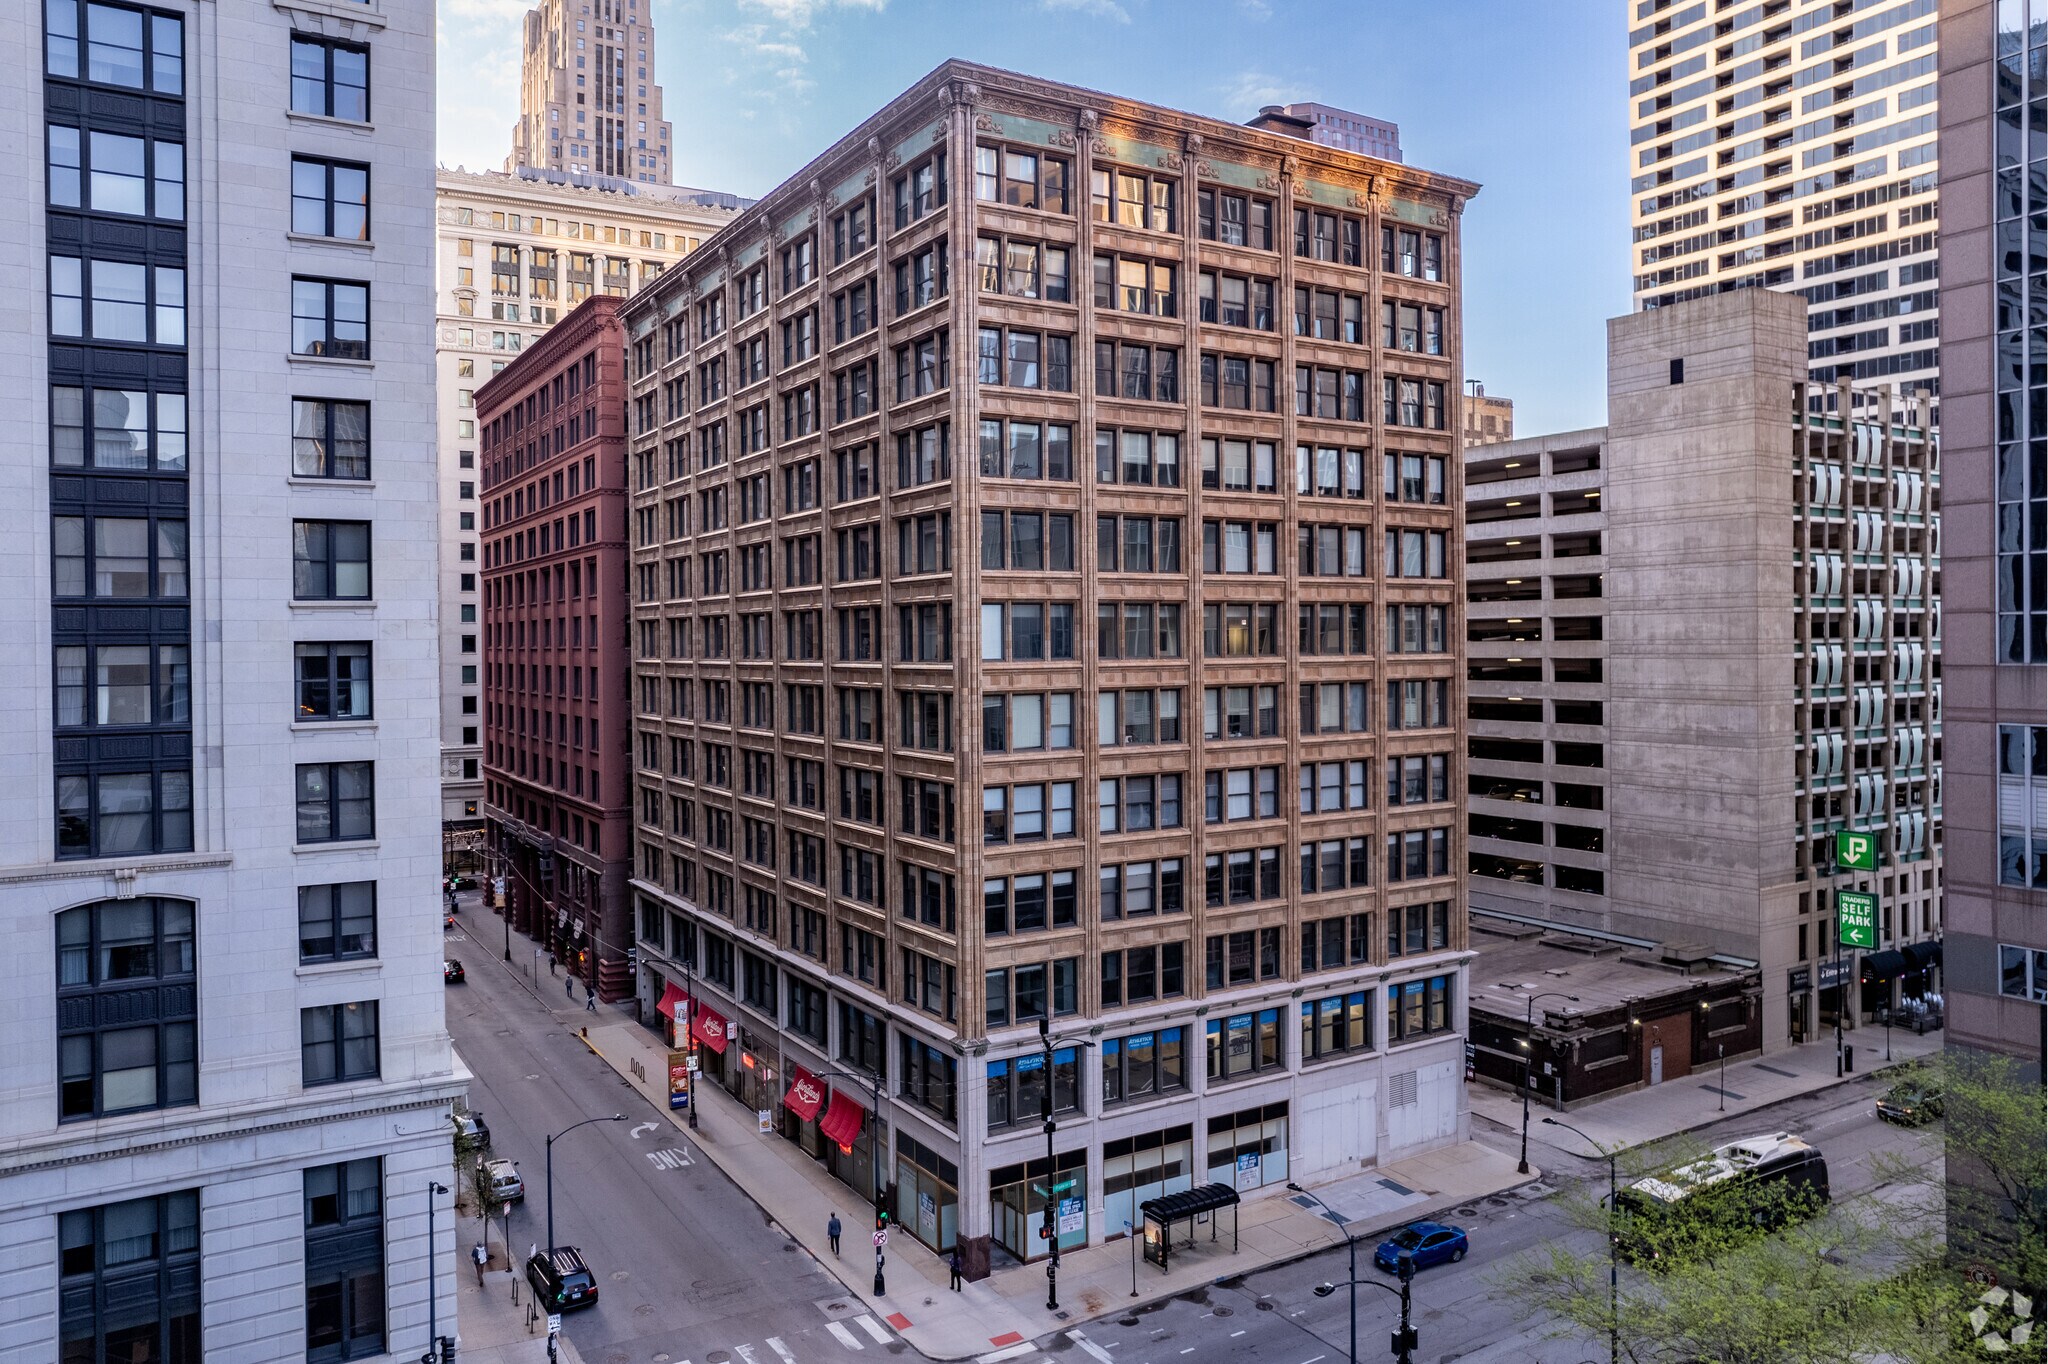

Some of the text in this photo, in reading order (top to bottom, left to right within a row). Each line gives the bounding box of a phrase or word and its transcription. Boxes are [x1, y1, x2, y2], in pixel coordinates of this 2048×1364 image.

[1842, 895, 1870, 905] TRADERS
[1842, 903, 1870, 916] SELF
[1842, 914, 1871, 927] PARK
[1826, 967, 1845, 977] Entrace
[1129, 1036, 1152, 1044] ATHLETICO
[646, 1146, 696, 1170] ONLY
